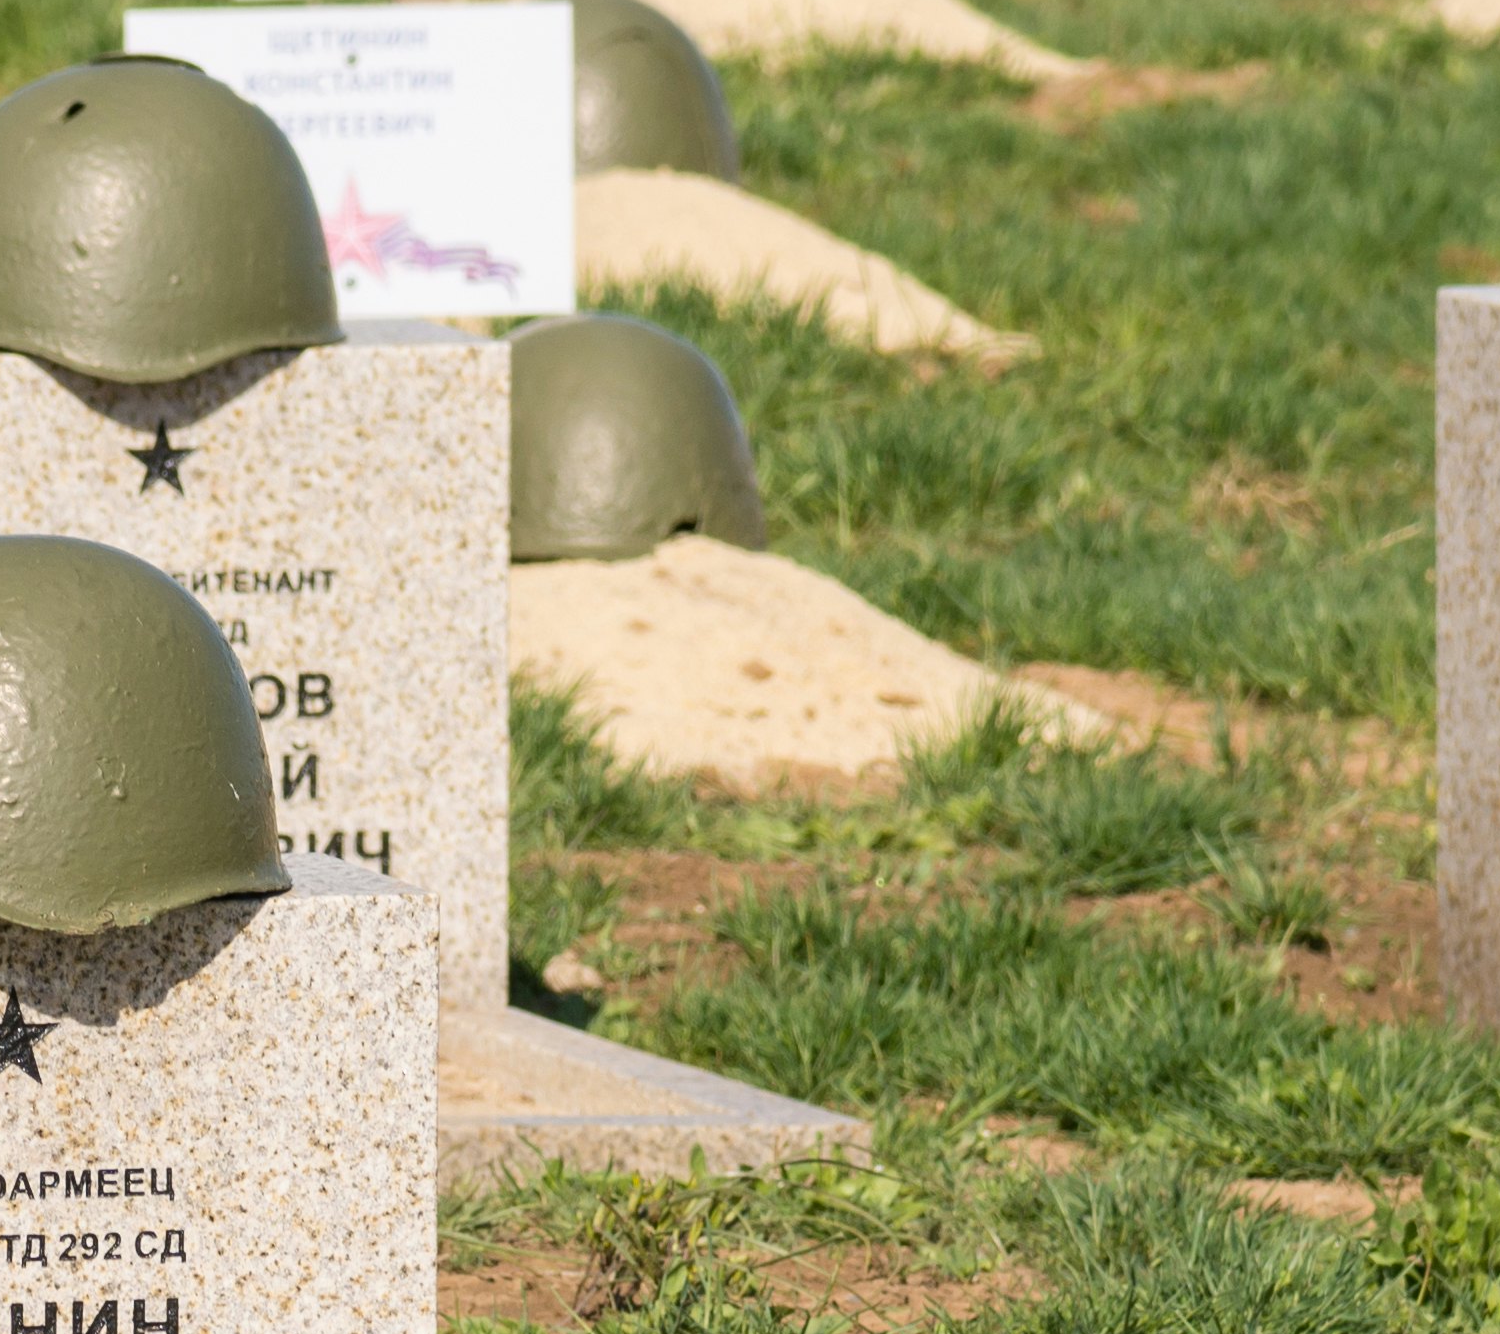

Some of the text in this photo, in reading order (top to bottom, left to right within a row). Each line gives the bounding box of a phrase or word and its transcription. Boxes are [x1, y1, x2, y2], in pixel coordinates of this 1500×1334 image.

[268, 26, 428, 53] ЩЕТИНИН
[244, 67, 453, 96] КОНСТАНТИН
[283, 112, 434, 137] ЕРГЕЕВИЧ
[59, 1232, 122, 1261] 292
[134, 1229, 187, 1263] СД
